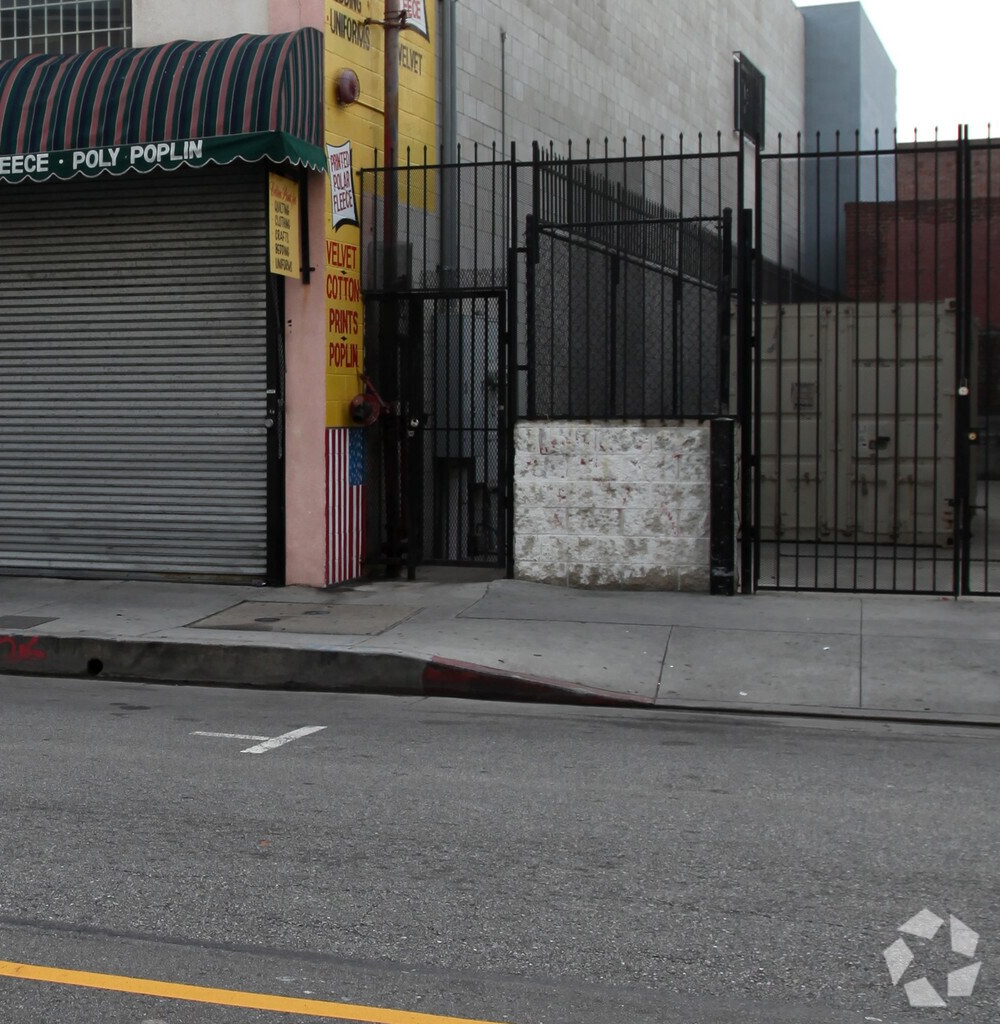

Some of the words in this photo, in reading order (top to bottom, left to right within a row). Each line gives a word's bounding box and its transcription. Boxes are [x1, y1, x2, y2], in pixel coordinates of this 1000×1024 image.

[329, 8, 371, 52] UNIFORMS
[72, 147, 121, 170] POLY
[130, 139, 204, 164] POPLIN
[330, 150, 350, 172] PRINTED
[332, 170, 351, 192] POLAR
[333, 189, 353, 213] FLEECE
[325, 240, 357, 270] VELVET
[326, 274, 360, 303] COTTON
[328, 308, 358, 334] PRINTS
[328, 342, 358, 368] POPLIN
